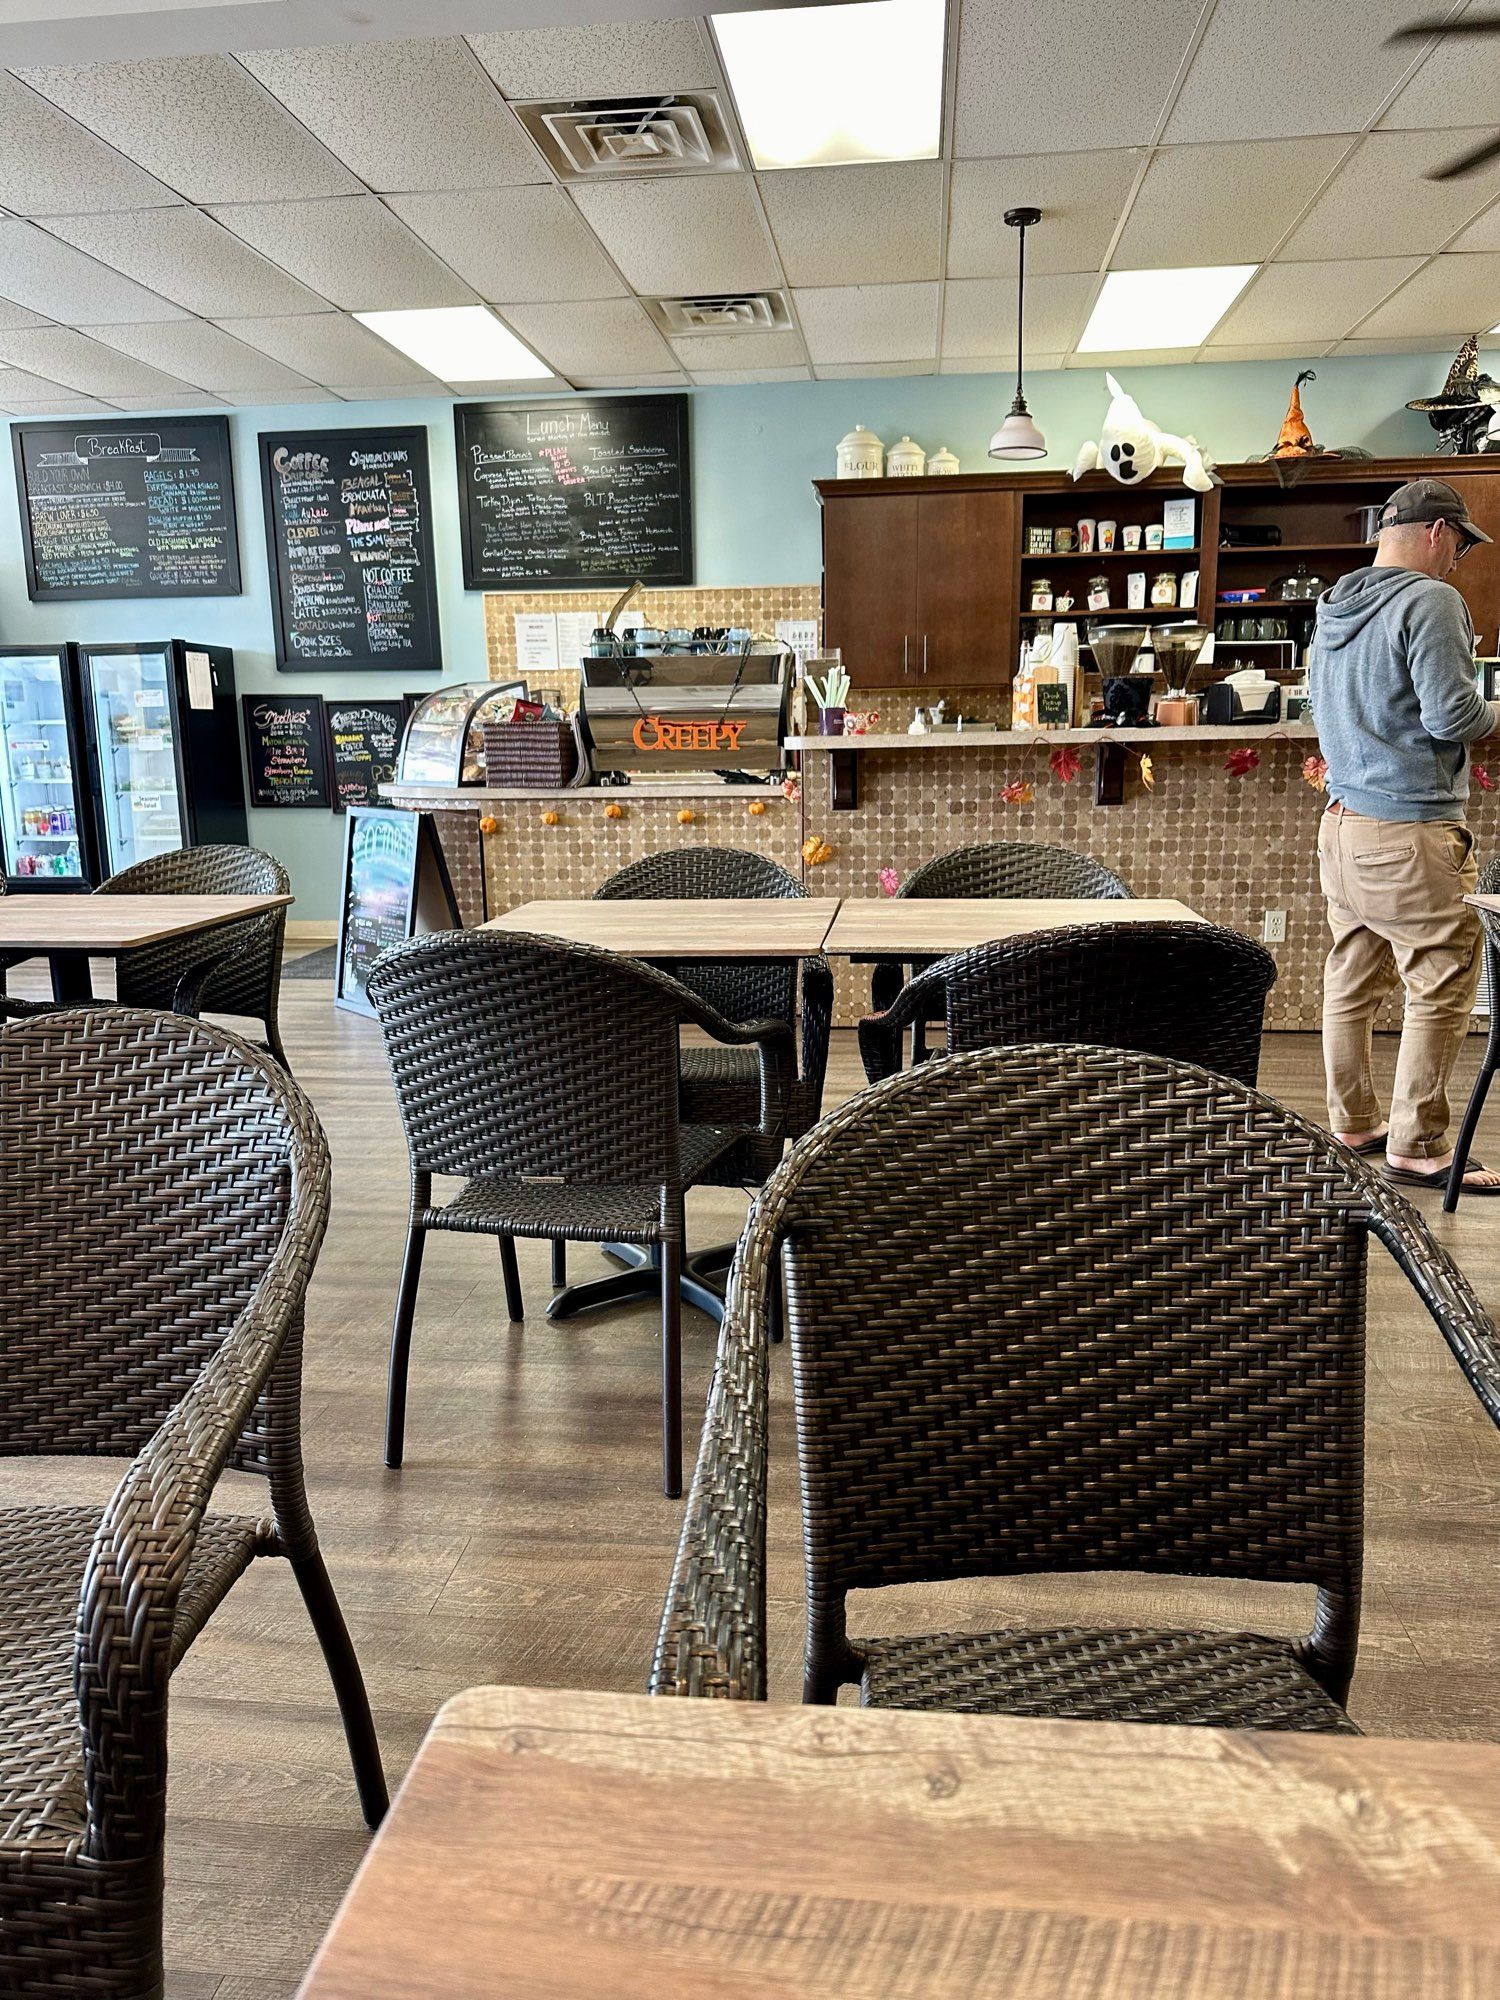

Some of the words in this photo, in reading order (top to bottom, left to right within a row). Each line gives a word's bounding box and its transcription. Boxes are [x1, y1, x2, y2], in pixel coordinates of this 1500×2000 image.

[527, 413, 575, 436] Lunch
[580, 412, 609, 434] Menu
[87, 437, 147, 457] Breakfast
[588, 446, 624, 459] Toasted
[844, 461, 878, 471] FLOUR
[381, 567, 414, 583] COFFEE
[294, 606, 321, 620] LATTE
[1043, 691, 1060, 699] Drink
